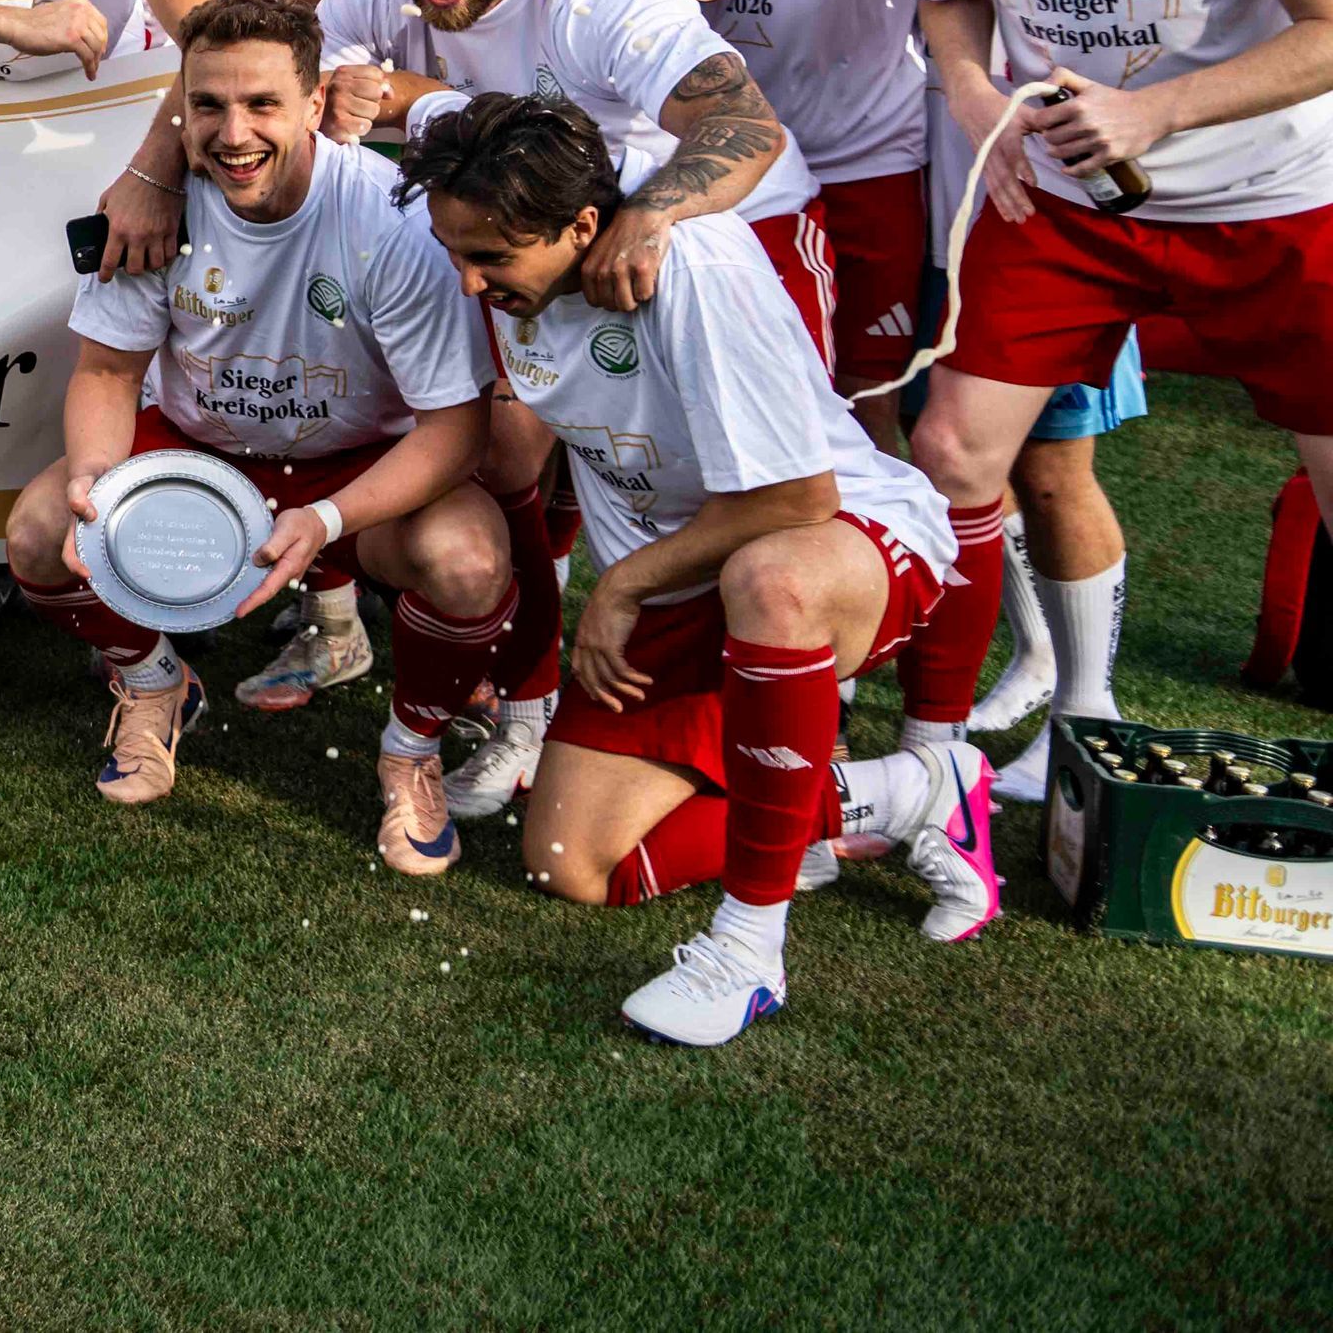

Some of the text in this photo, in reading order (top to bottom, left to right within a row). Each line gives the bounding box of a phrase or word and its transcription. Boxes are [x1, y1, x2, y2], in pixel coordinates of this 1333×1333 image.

[1020, 15, 1162, 54] Kreispokal
[174, 284, 255, 327] Bitburger
[220, 368, 298, 399] Sieger
[195, 387, 330, 424] Kreispokal
[1209, 882, 1333, 932] Bitburger
